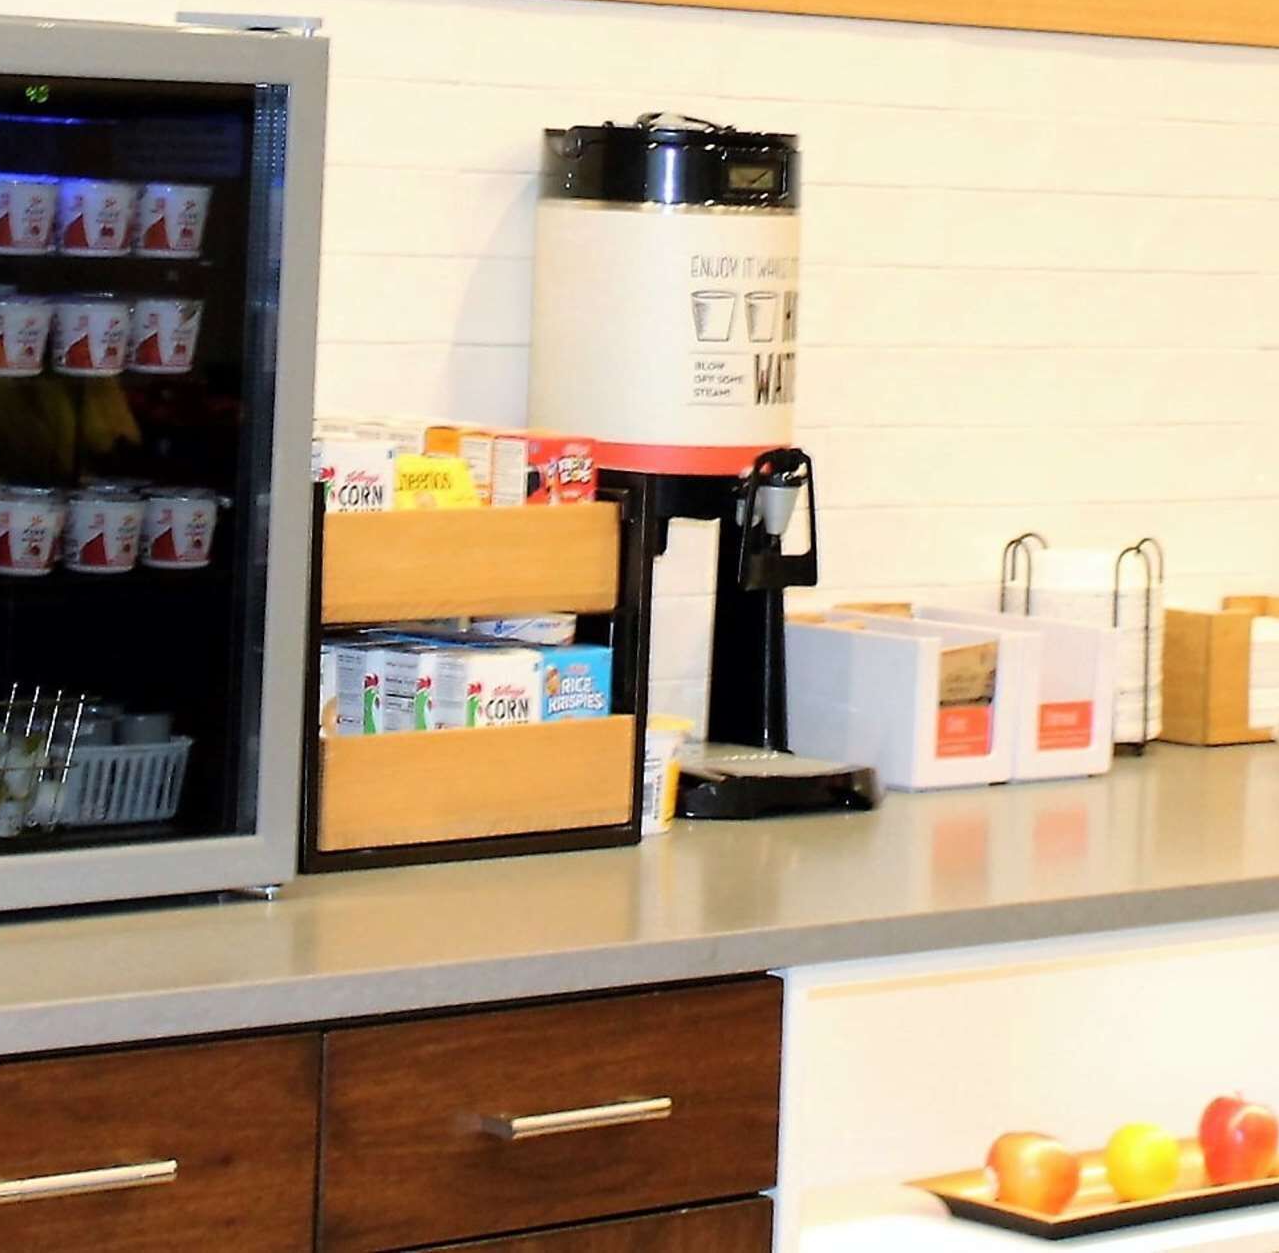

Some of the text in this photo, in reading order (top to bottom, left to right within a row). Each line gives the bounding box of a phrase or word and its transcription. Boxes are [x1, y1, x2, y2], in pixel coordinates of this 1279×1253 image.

[690, 255, 738, 279] ENJOY
[741, 257, 754, 279] IT
[338, 484, 384, 507] CORN
[560, 676, 593, 695] RICE
[484, 697, 529, 720] CORN
[547, 693, 605, 714] KRISPIES
